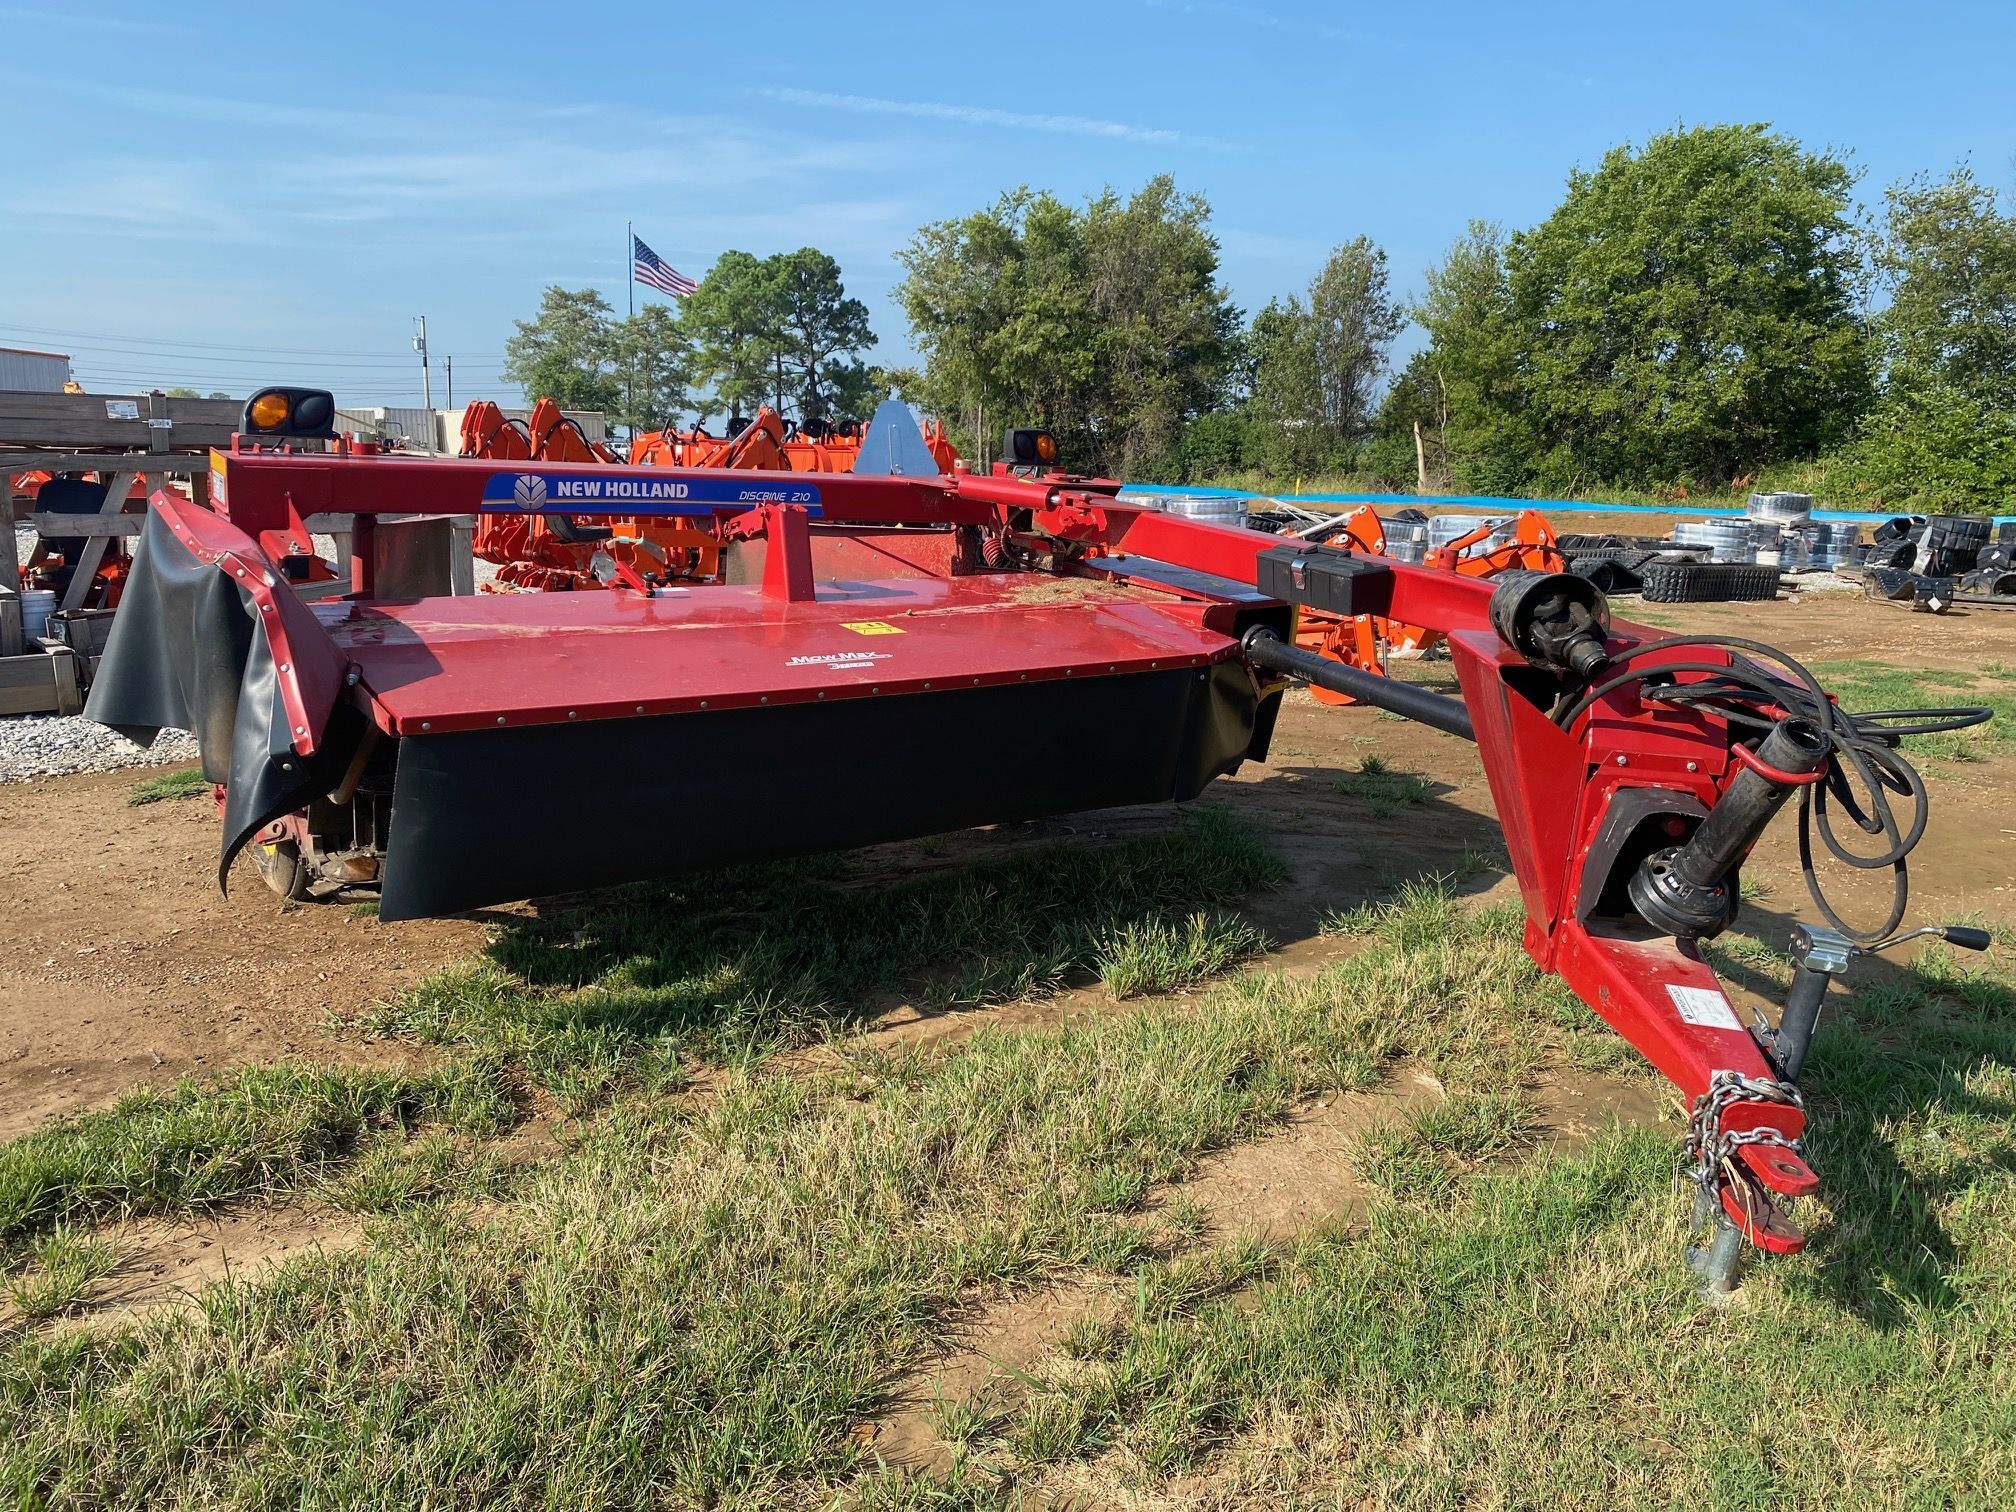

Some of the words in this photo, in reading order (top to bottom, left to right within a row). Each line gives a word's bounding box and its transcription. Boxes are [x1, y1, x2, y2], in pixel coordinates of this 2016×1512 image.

[557, 481, 601, 497] NEW
[605, 482, 689, 498] HOLLAND
[738, 490, 788, 502] DISCBINE
[791, 492, 811, 502] 210
